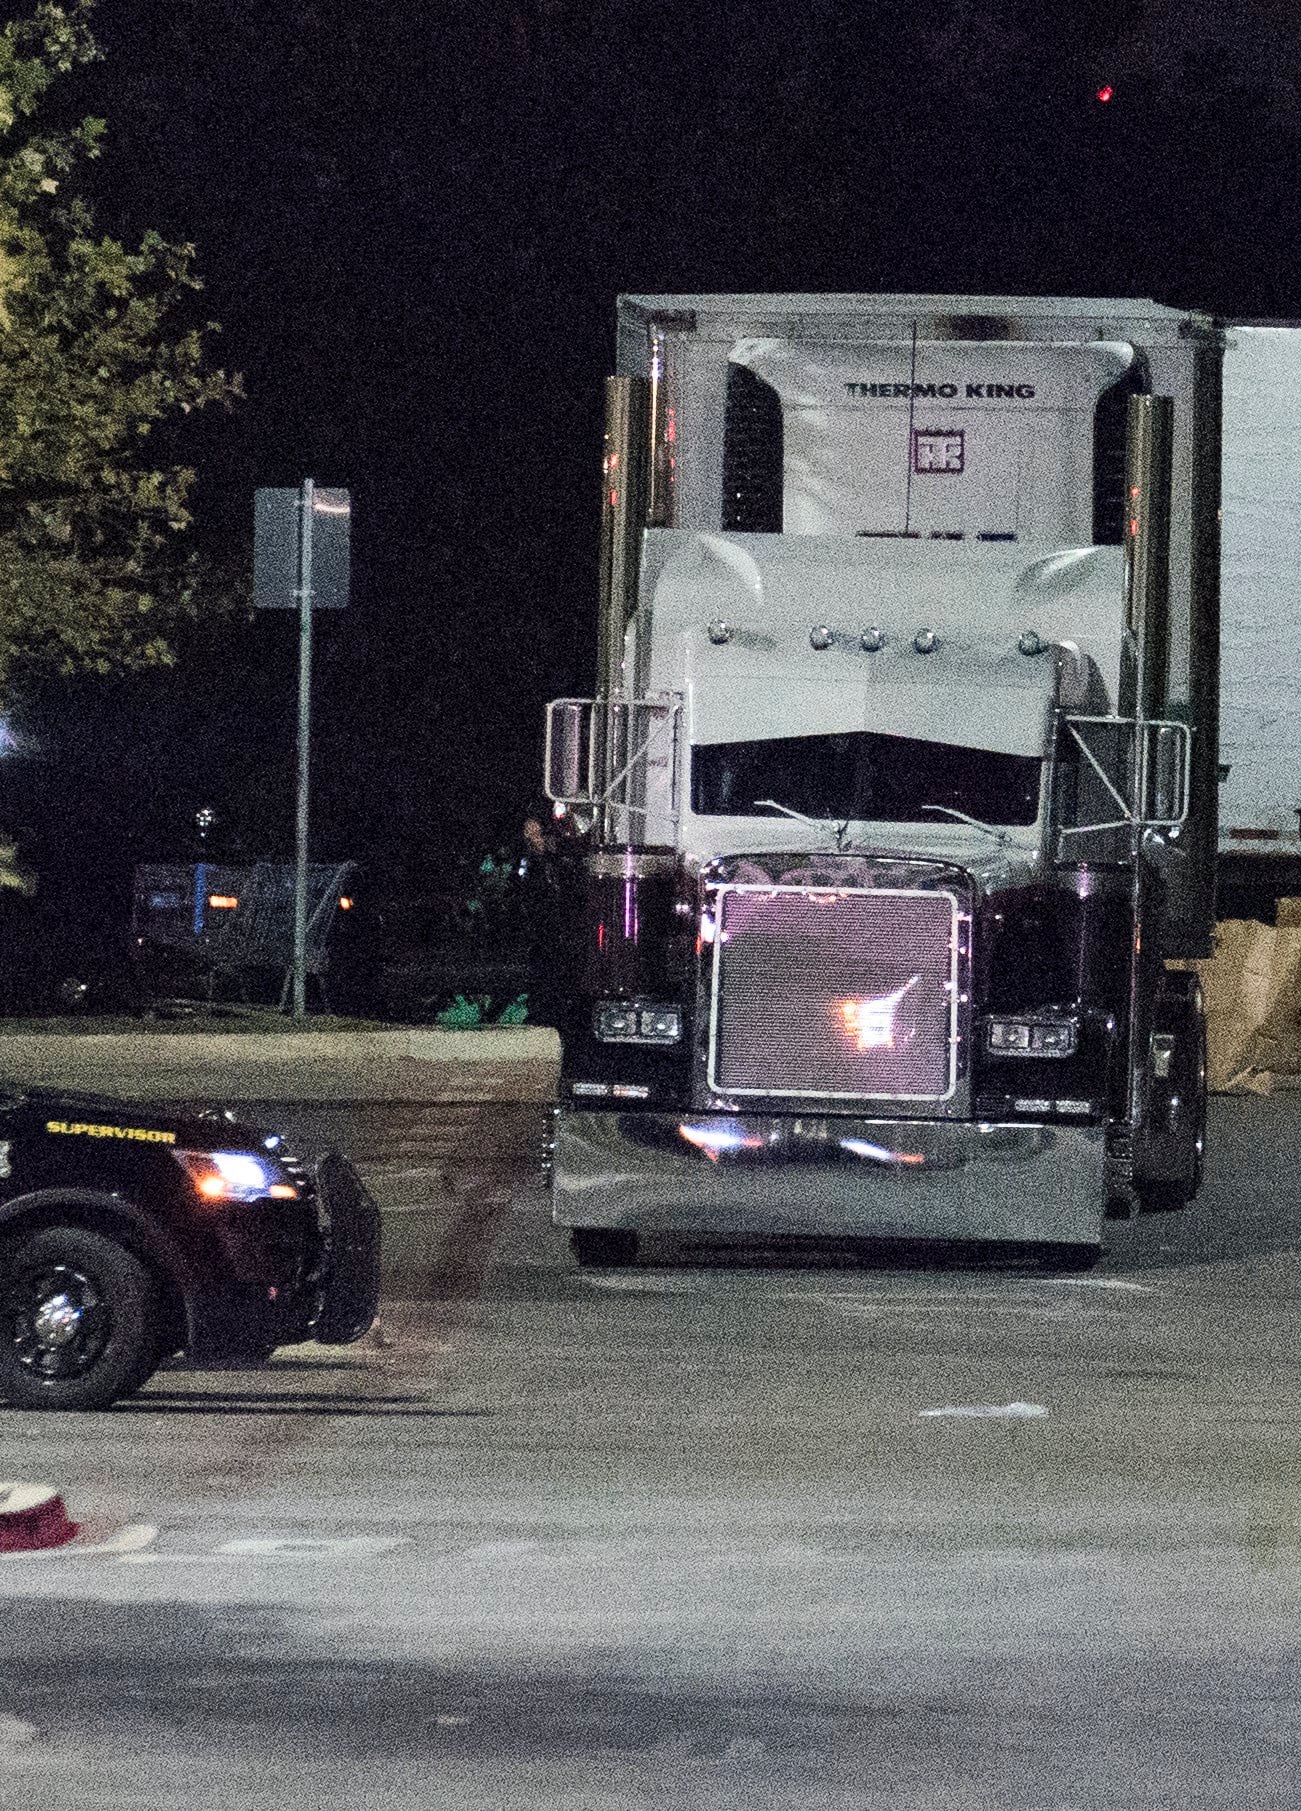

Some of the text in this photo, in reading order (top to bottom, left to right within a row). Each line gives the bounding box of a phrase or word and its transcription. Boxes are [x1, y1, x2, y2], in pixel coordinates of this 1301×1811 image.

[844, 383, 1036, 398] THERMO KING
[46, 1121, 176, 1144] SUPERVISOR
